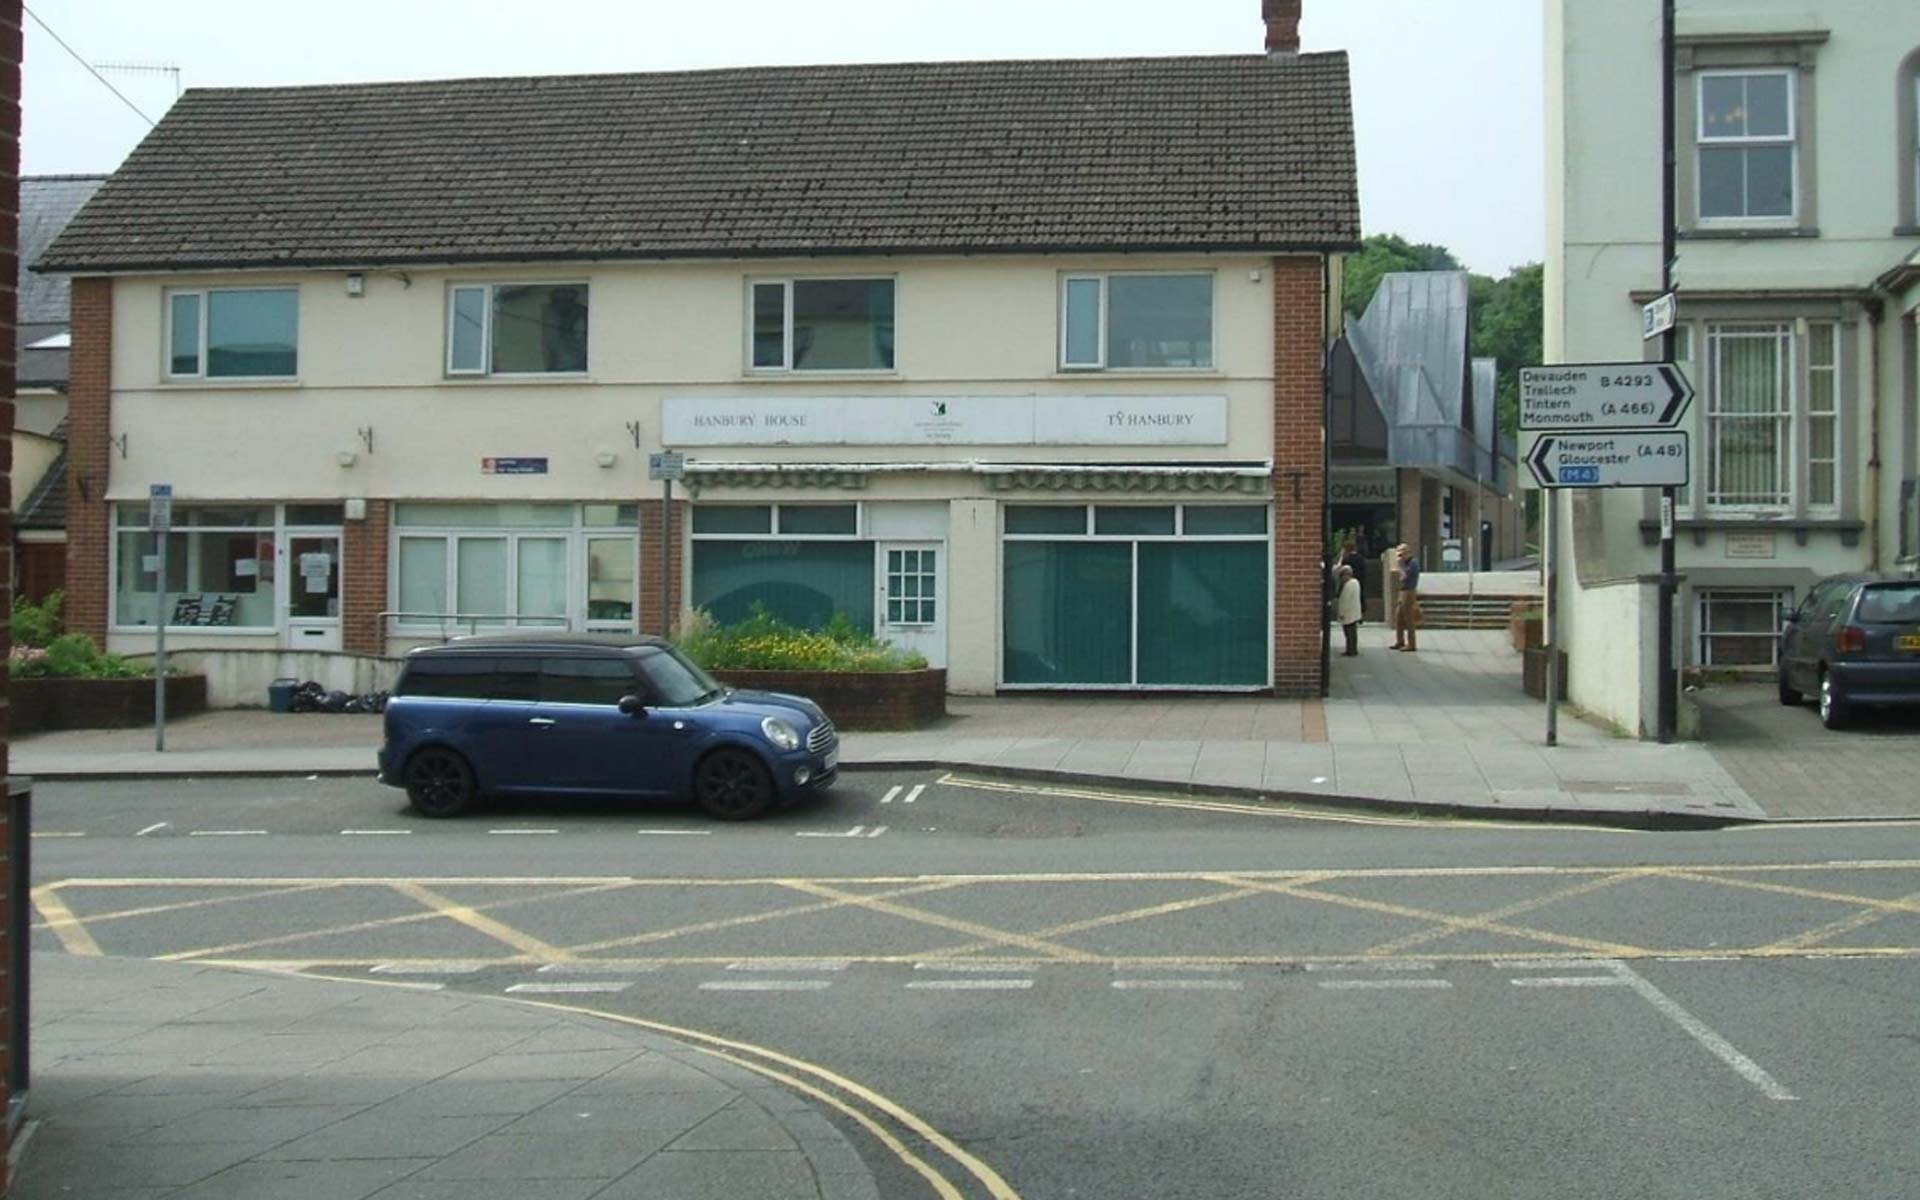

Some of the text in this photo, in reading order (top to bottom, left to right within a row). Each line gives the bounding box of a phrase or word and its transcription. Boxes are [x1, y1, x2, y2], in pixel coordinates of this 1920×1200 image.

[1523, 371, 1587, 383] Devauden
[1601, 375, 1654, 387] B 4293
[1524, 385, 1576, 396] Trellech
[1524, 399, 1571, 410] Tintern
[1601, 402, 1655, 416] (A 466)
[694, 414, 807, 426] HANBURY HOUSE
[1128, 413, 1193, 426] HANBURY
[1523, 412, 1594, 424] Monmouth
[1559, 440, 1615, 453] Newport
[1637, 444, 1683, 458] (A 48)
[1559, 454, 1630, 465] Gloucester
